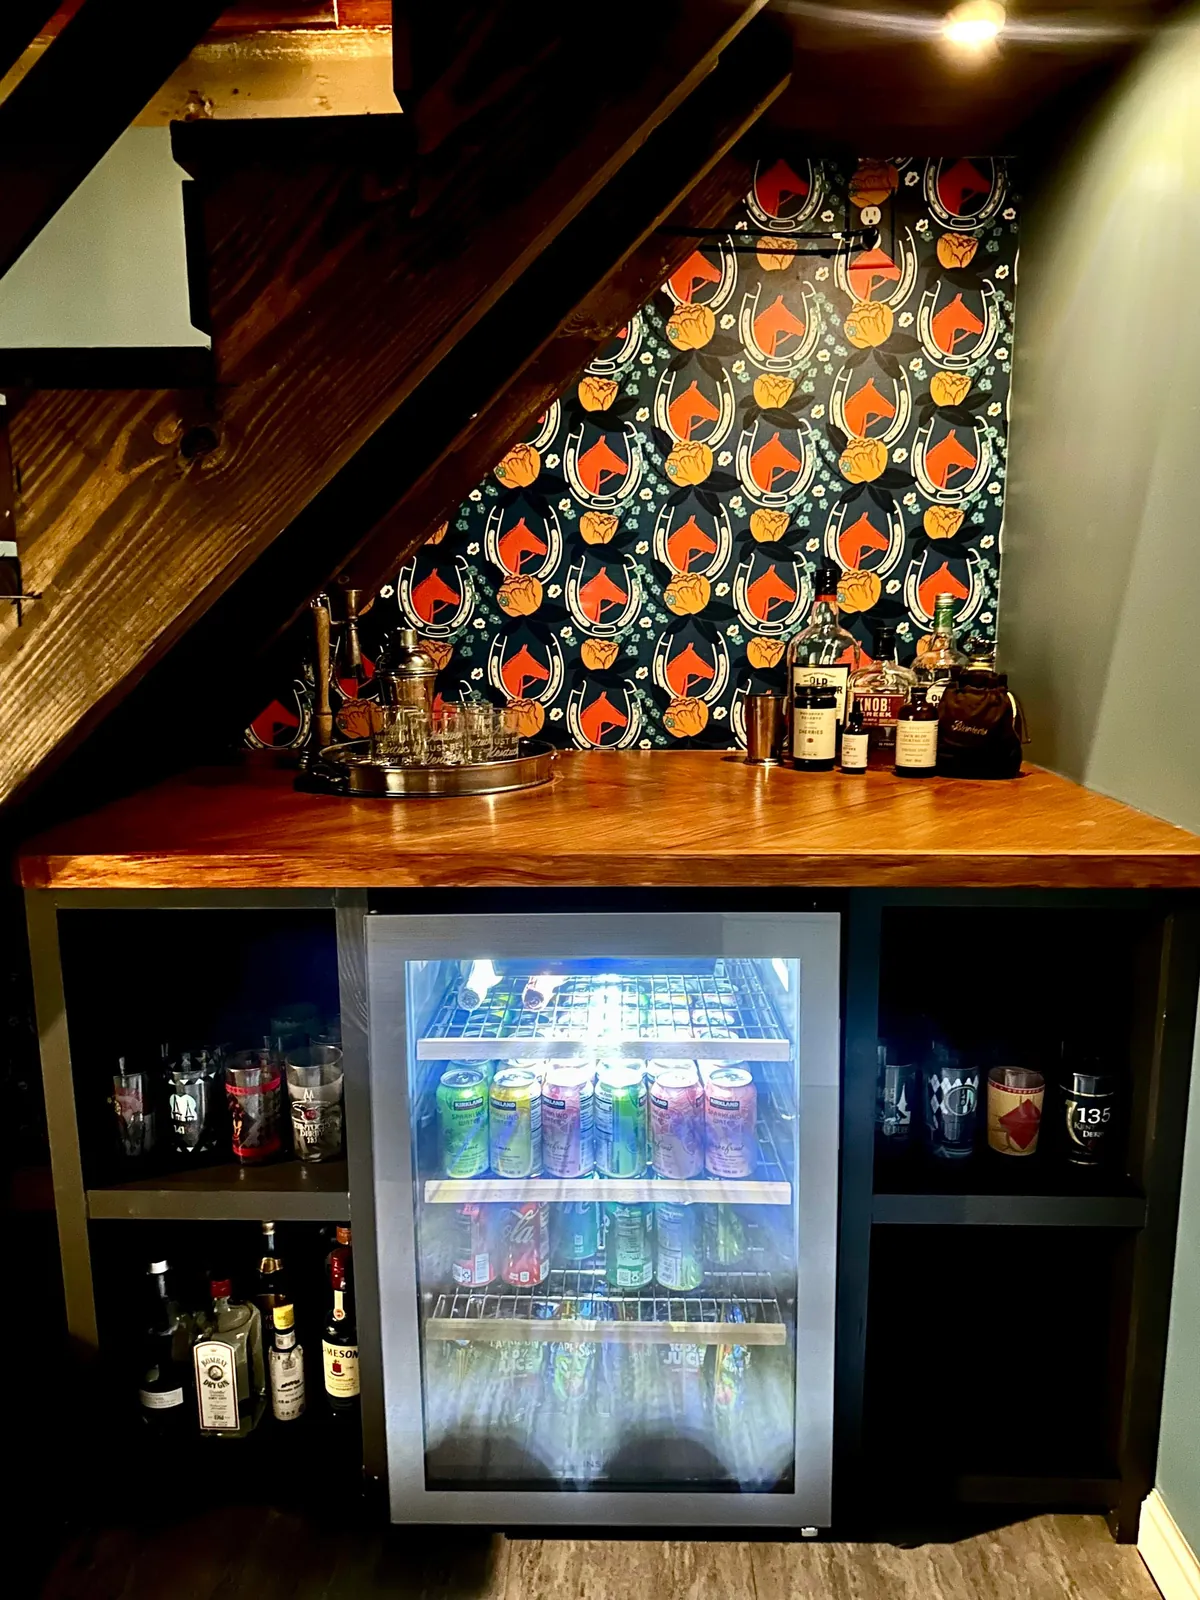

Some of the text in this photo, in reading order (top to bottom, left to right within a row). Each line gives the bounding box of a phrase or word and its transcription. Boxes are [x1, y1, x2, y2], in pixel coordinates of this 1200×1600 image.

[1077, 1106, 1111, 1124] 135
[323, 1348, 359, 1360] MESON
[203, 1379, 230, 1389] DRY GIN
